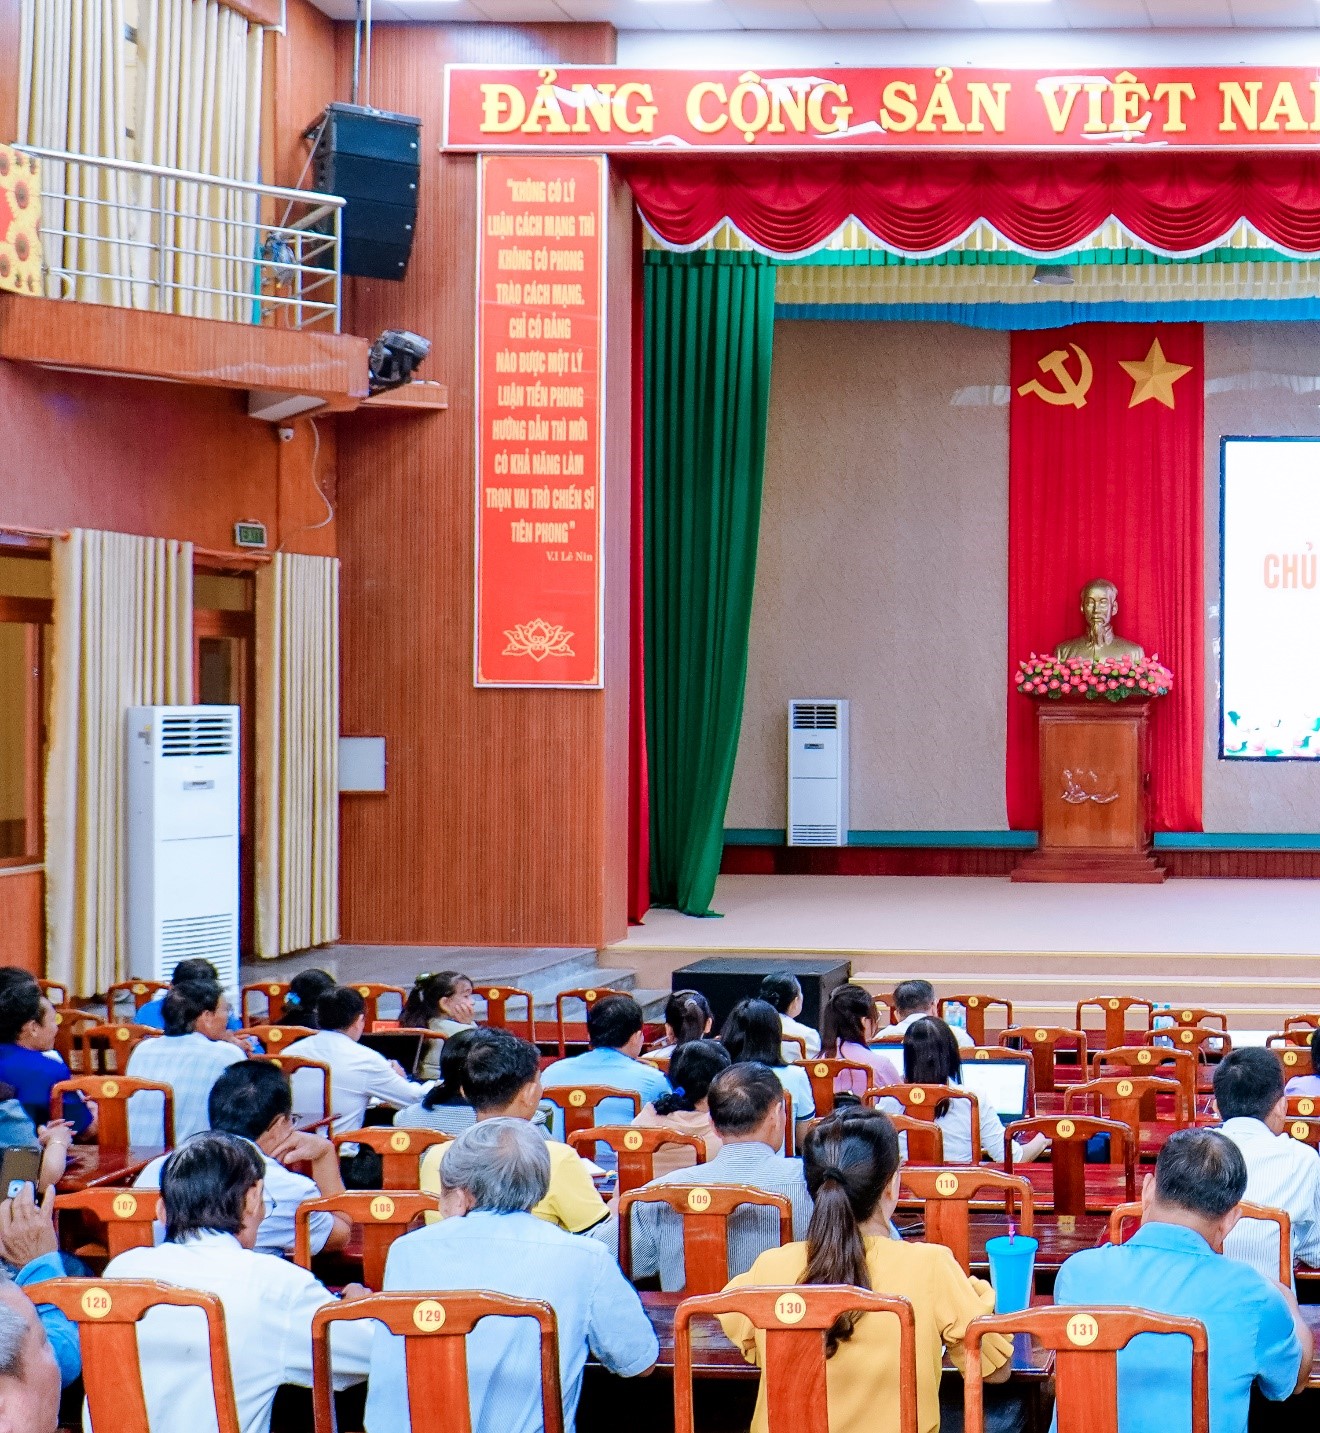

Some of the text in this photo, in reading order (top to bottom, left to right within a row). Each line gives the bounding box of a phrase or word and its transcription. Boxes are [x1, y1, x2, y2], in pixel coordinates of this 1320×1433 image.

[479, 68, 659, 134] ĐẢNG
[686, 70, 854, 143] CỘNG
[880, 67, 1012, 133] SẢN
[1036, 70, 1197, 142] VIỆT
[548, 178, 562, 203] CÓ
[563, 177, 576, 202] LÝ
[487, 211, 595, 240] LUẬN CÁCH MẠNG THÌ
[498, 245, 584, 271] KHÔNG CÓ PHONG
[495, 280, 522, 305] TRÀO
[523, 280, 550, 305] CÁCH
[509, 311, 571, 339] CHỈ CÓ ĐẢNG
[496, 348, 517, 373] NÀO
[547, 348, 569, 377] MỘT
[571, 348, 583, 373] LÝ
[497, 382, 524, 410] LUẬN
[549, 386, 584, 408] PHONG
[551, 416, 567, 441] THÌ
[494, 448, 584, 475] CÓ KHẢ NĂNG LÀM
[485, 484, 595, 512] TRỌN VAI TRÒ CHIẾN SĨ
[561, 551, 573, 561] Lê
[575, 551, 593, 561] Nin
[1263, 541, 1318, 590] CHỦ
[1296, 1126, 1305, 1134] 91
[938, 1179, 955, 1188] 110
[117, 1201, 133, 1210] 107
[374, 1203, 391, 1212] 108
[691, 1195, 708, 1204] 109
[86, 1296, 107, 1309] 128
[779, 1302, 802, 1314] 130
[418, 1310, 441, 1322] 129
[1072, 1323, 1094, 1335] 131
